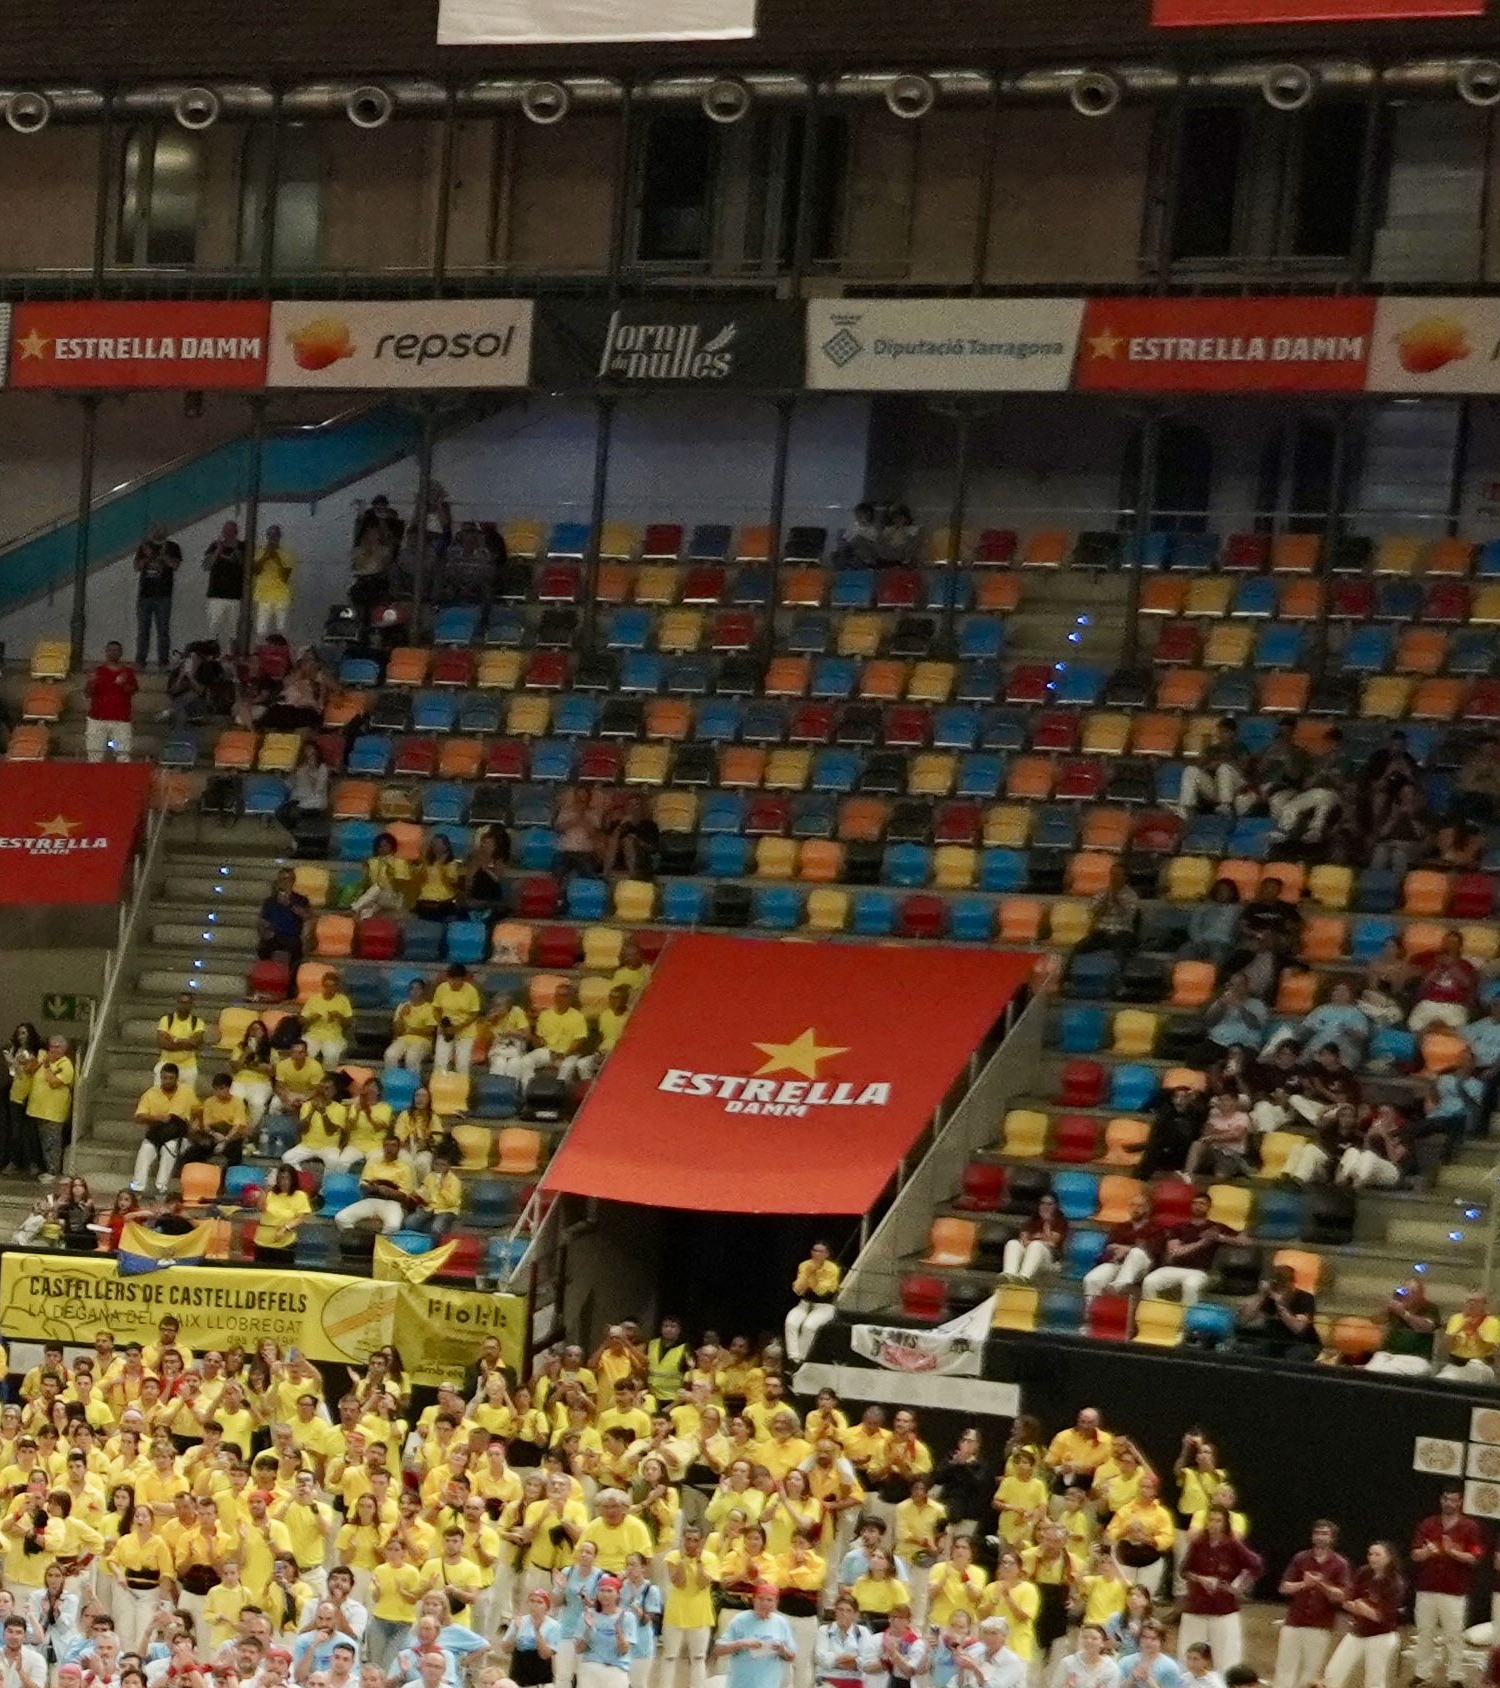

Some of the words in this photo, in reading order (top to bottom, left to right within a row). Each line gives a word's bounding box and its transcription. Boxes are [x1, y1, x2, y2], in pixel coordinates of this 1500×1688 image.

[54, 337, 176, 361] ESTRELLA
[184, 337, 261, 360] DAMM
[373, 326, 516, 364] repsol
[1127, 337, 1268, 361] ESTRELLA
[1274, 337, 1363, 360] DAMM
[658, 1068, 892, 1105] ESTRELLA
[723, 1100, 811, 1118] DAMM
[28, 1275, 137, 1302] CASTELLERS
[145, 1285, 164, 1304] DE
[168, 1287, 308, 1313] CASTELLDEFELS
[27, 1304, 44, 1317] LA
[51, 1304, 121, 1322] DEGANA
[130, 1310, 157, 1326] DEL
[162, 1312, 201, 1329] AIX
[206, 1316, 304, 1334] LLOBREGAT
